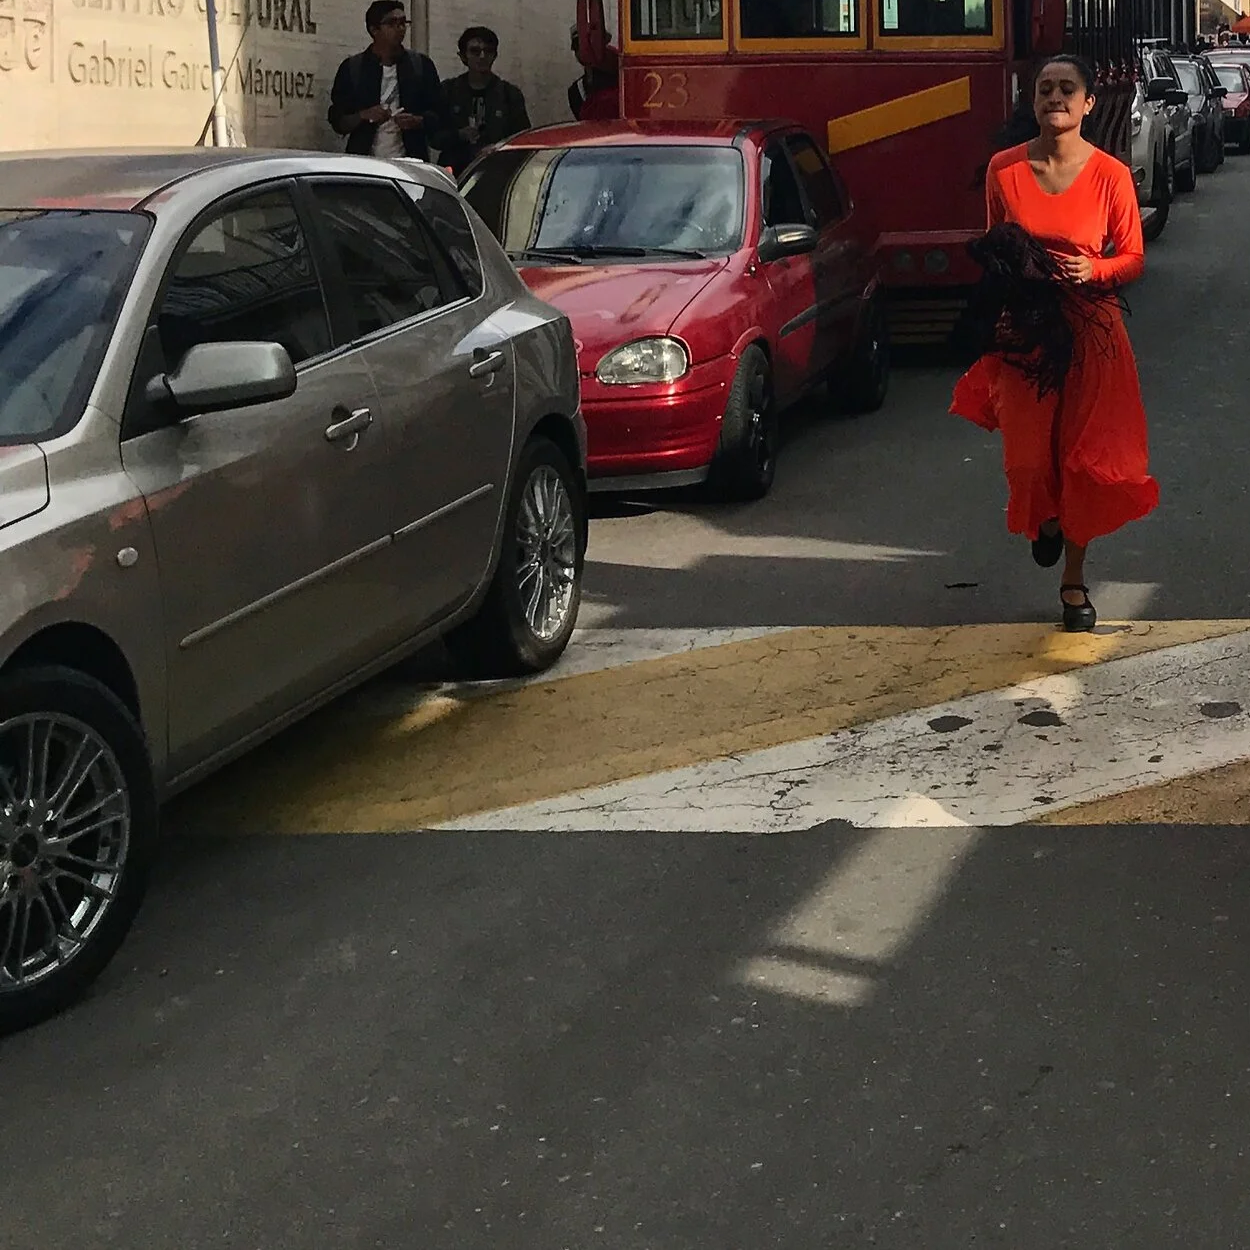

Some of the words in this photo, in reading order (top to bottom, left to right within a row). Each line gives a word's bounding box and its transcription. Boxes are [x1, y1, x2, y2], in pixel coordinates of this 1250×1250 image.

[67, 40, 154, 88] Gabriel
[162, 50, 228, 94] Garca
[235, 57, 315, 109] Márquez
[642, 70, 689, 110] 23
